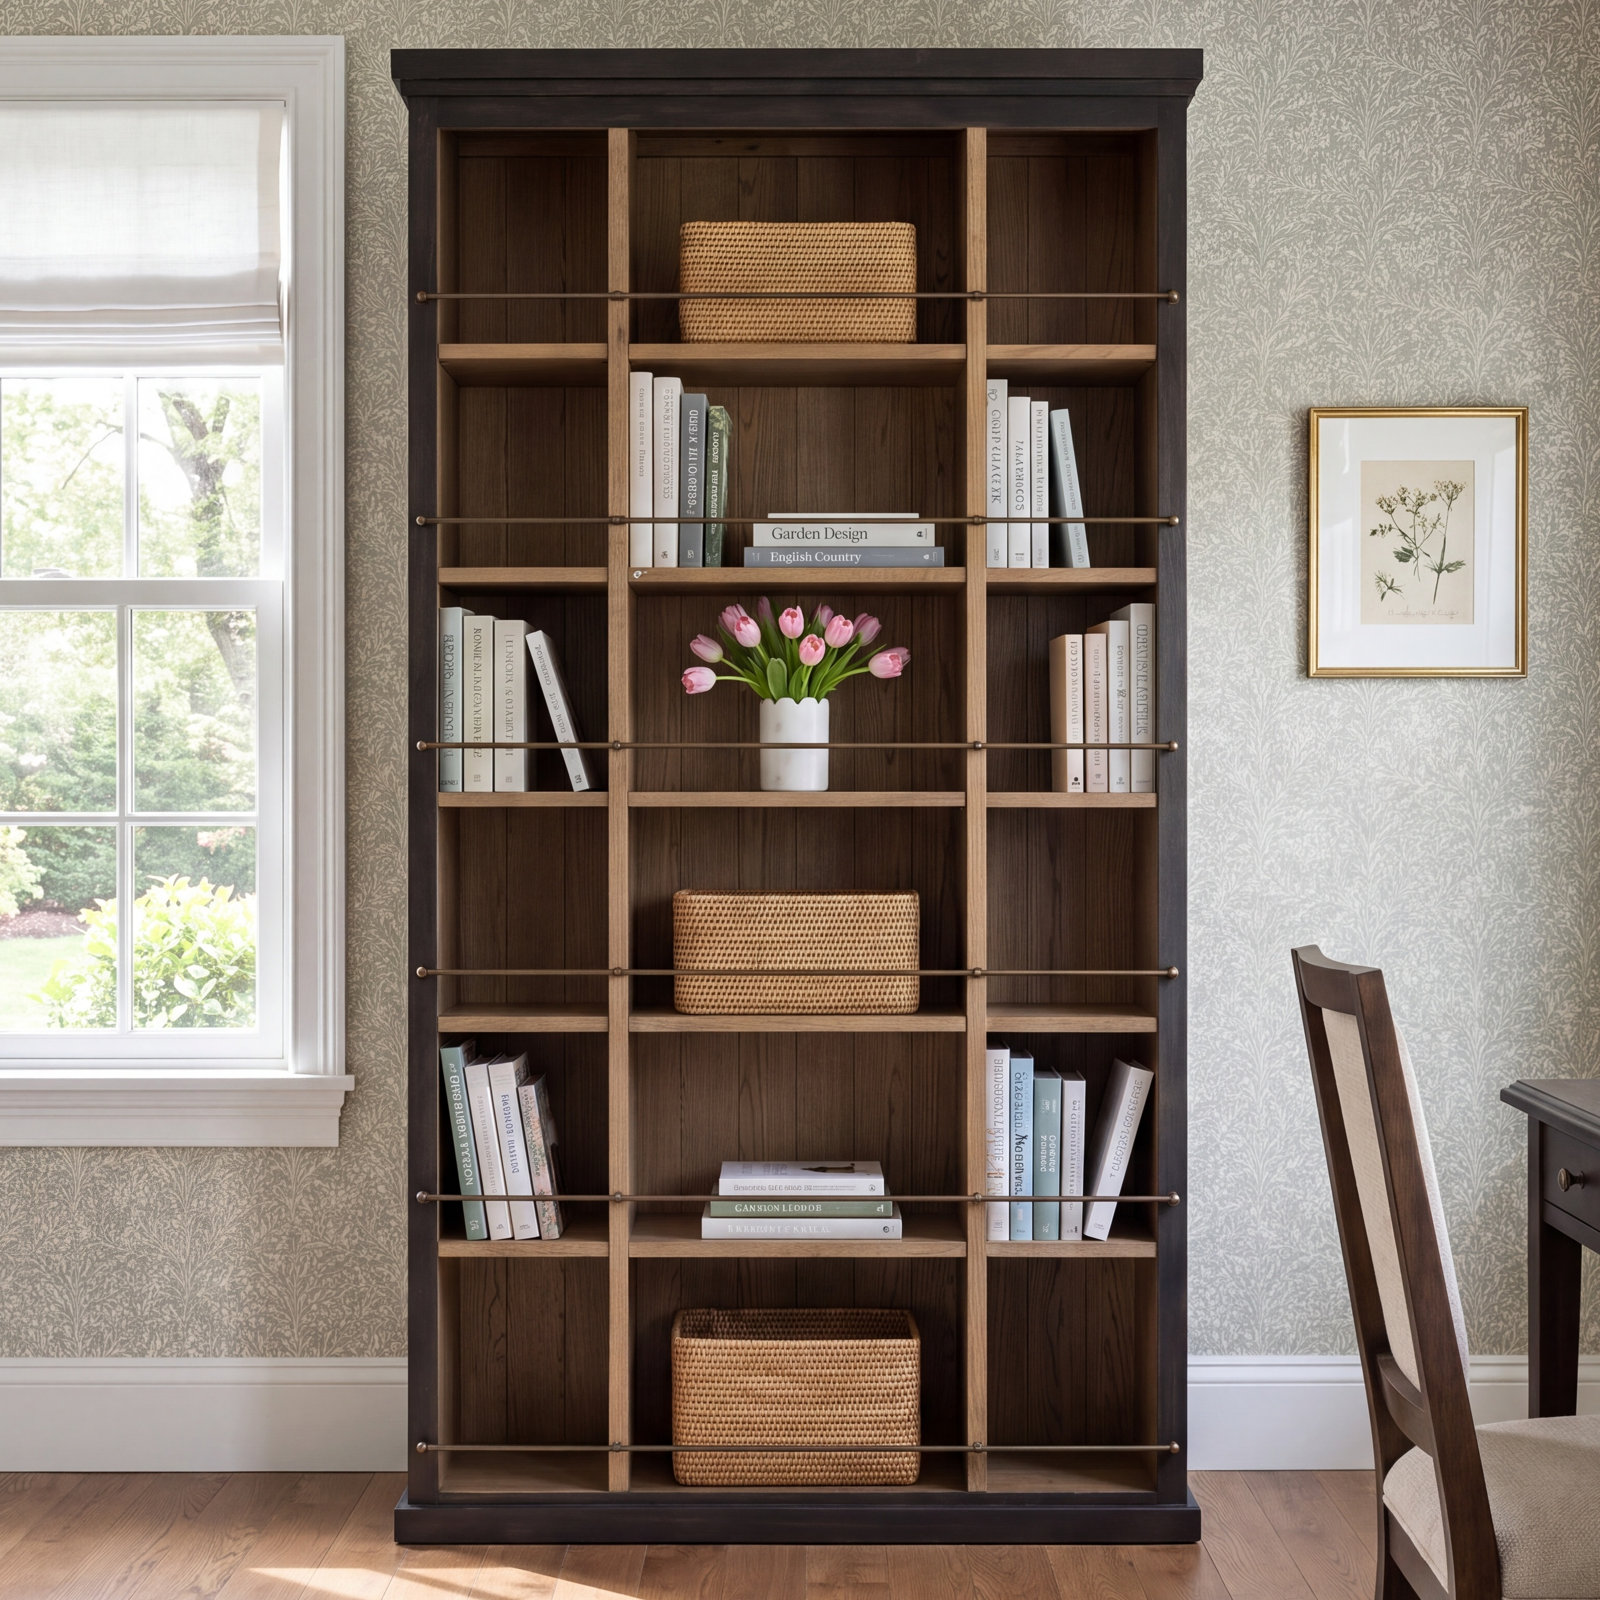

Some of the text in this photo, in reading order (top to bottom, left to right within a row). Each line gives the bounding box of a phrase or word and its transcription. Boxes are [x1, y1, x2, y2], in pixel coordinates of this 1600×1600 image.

[771, 526, 868, 544] Garden Design
[814, 551, 862, 565] Country
